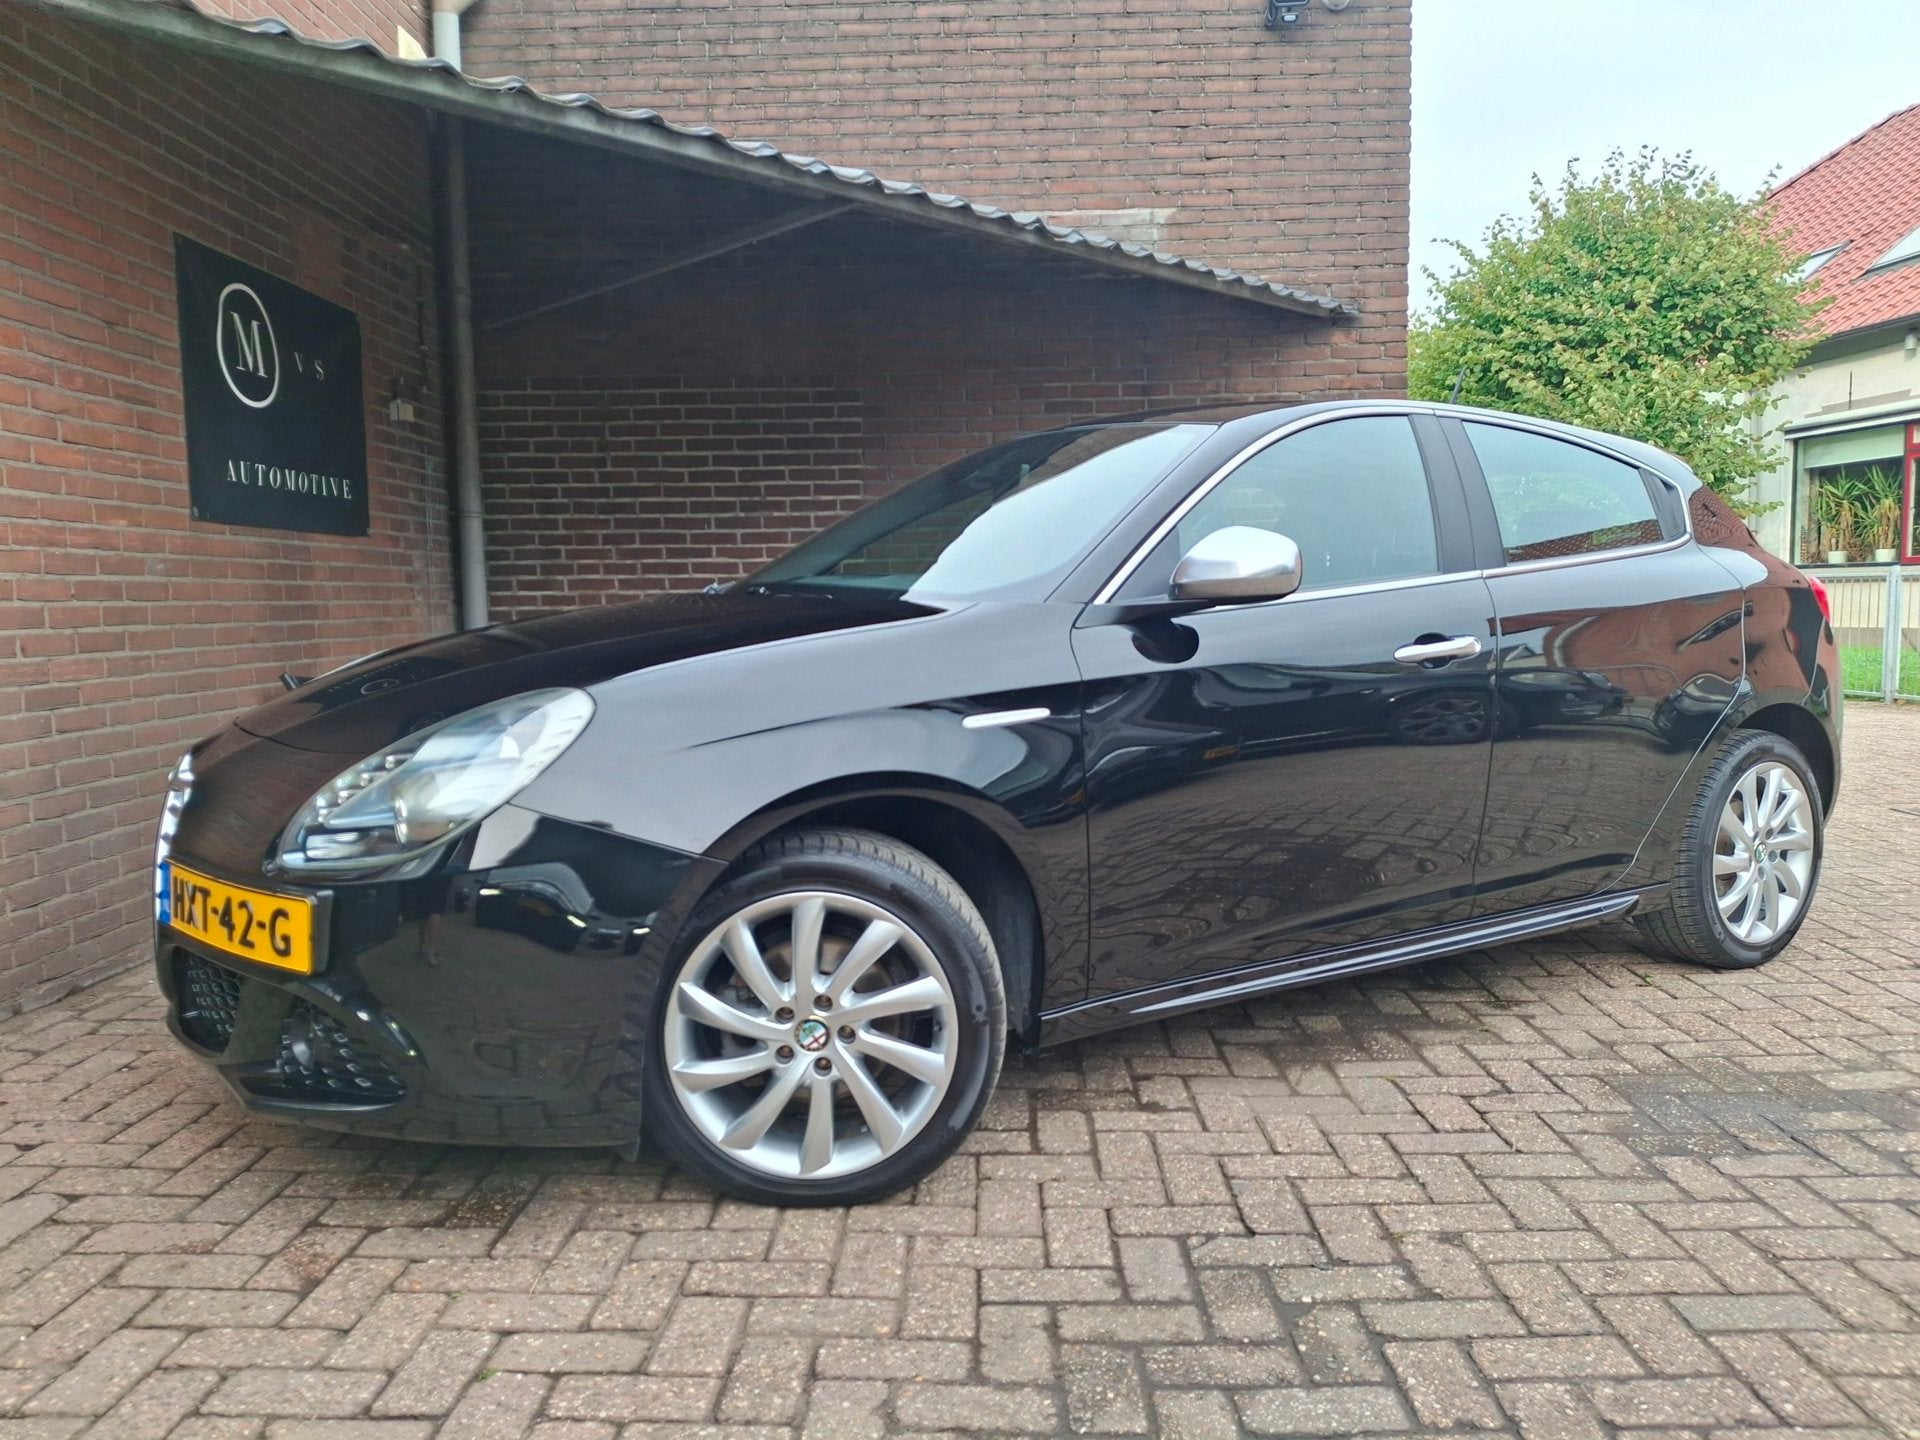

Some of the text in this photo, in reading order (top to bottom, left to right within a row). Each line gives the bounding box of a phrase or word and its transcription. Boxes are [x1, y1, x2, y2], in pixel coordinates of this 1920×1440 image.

[229, 311, 268, 378] M
[226, 458, 353, 500] AUTOMOTIVE
[172, 875, 293, 958] HXT-42-G
